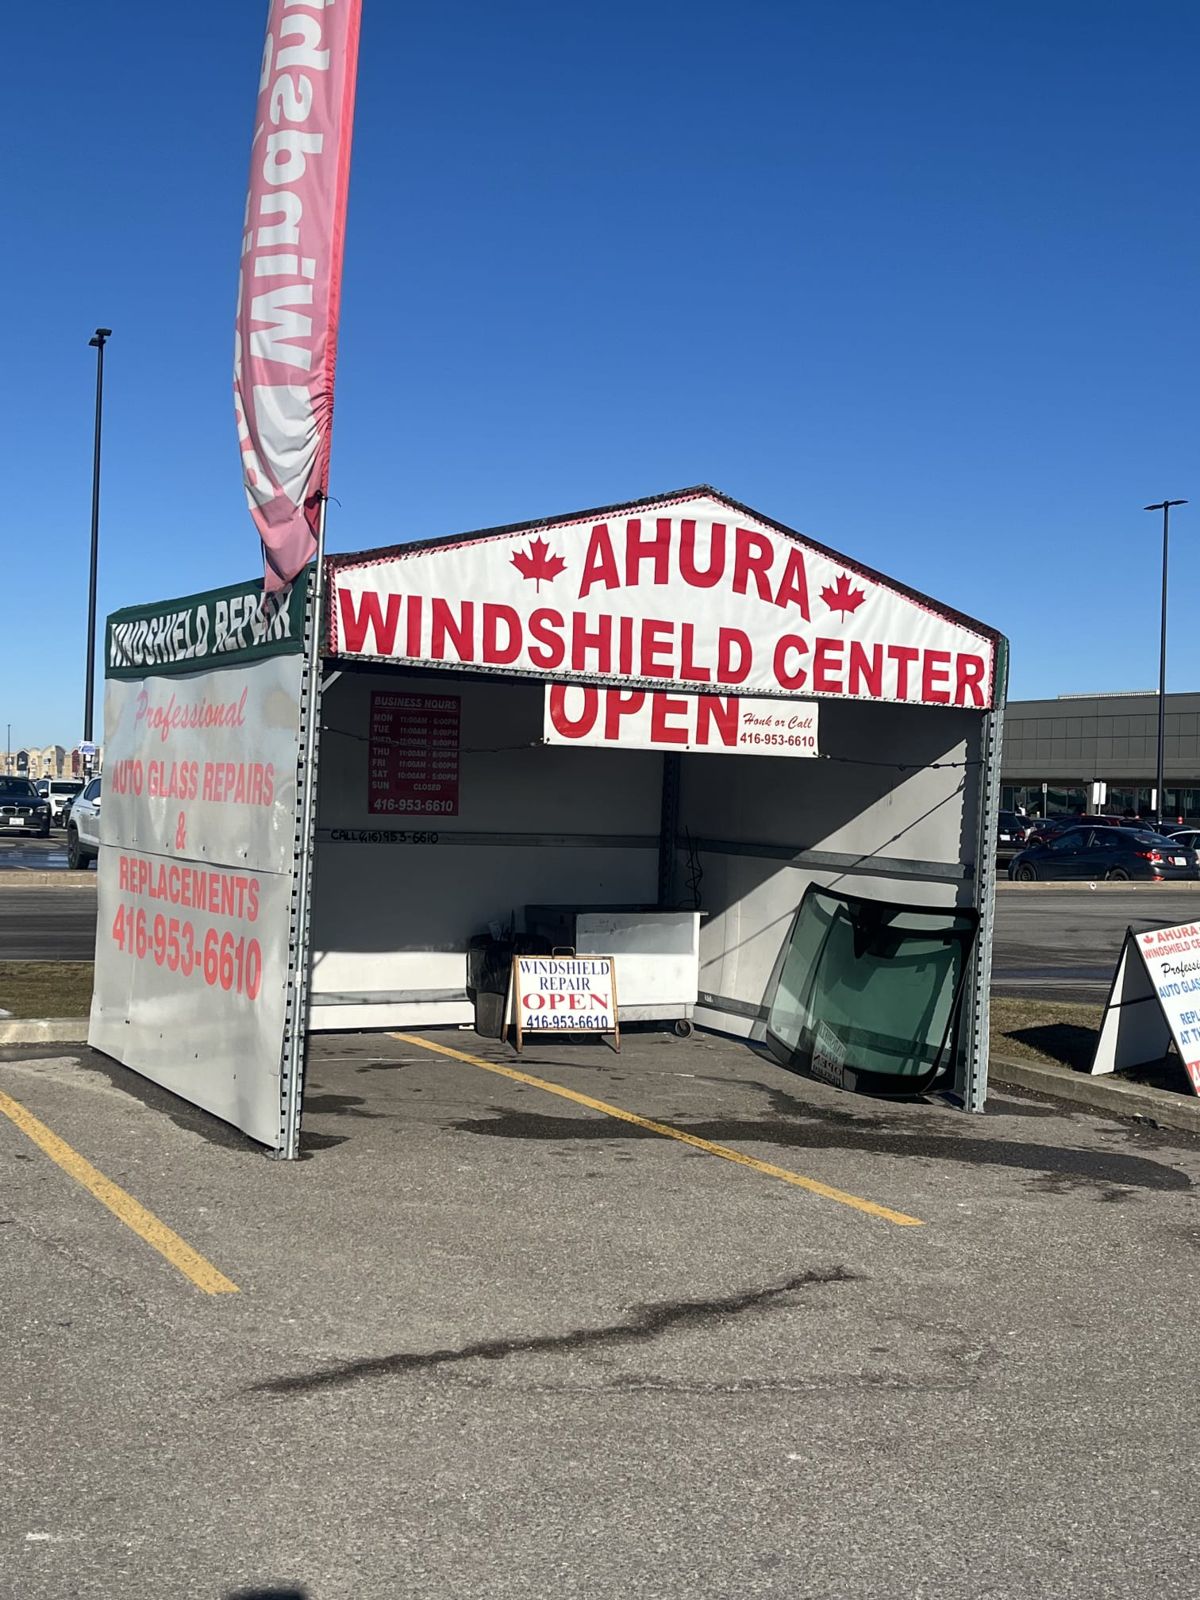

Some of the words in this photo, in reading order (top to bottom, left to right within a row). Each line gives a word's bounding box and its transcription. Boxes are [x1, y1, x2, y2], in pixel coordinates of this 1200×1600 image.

[578, 518, 811, 623] AHURA
[110, 604, 210, 668] WINDSHIELD
[338, 588, 753, 685] WINDSHIELD
[773, 634, 986, 708] CENTER
[374, 696, 423, 707] BUSINESS
[424, 699, 457, 710] HOURS
[134, 687, 249, 742] Professional
[374, 713, 393, 722] MON
[549, 682, 740, 747] OPEN
[743, 713, 773, 727] Honk
[788, 716, 813, 729] Call
[373, 725, 390, 733] TUE
[740, 732, 815, 747] 416-953-6610
[373, 747, 390, 756] THU
[372, 759, 386, 767] FRI
[372, 770, 388, 778] SAT
[112, 760, 143, 796] AUTO
[148, 761, 199, 801] GLASS
[202, 762, 275, 807] REPAIRS
[372, 781, 390, 790] SUN
[413, 783, 442, 791] CLOSED
[175, 811, 187, 850] &
[119, 856, 261, 922] REPLACEMENTS
[1157, 925, 1198, 943] AHURA
[112, 904, 262, 1001] 416-953-6610
[1143, 941, 1191, 960] WINDSHIELD
[520, 961, 610, 976] WINDSHIELD
[540, 977, 591, 991] REPAIR
[1158, 982, 1181, 999] AUTO
[522, 993, 609, 1010] OPEN
[526, 1014, 609, 1029] 416-953-6610
[1180, 1030, 1192, 1046] AT
